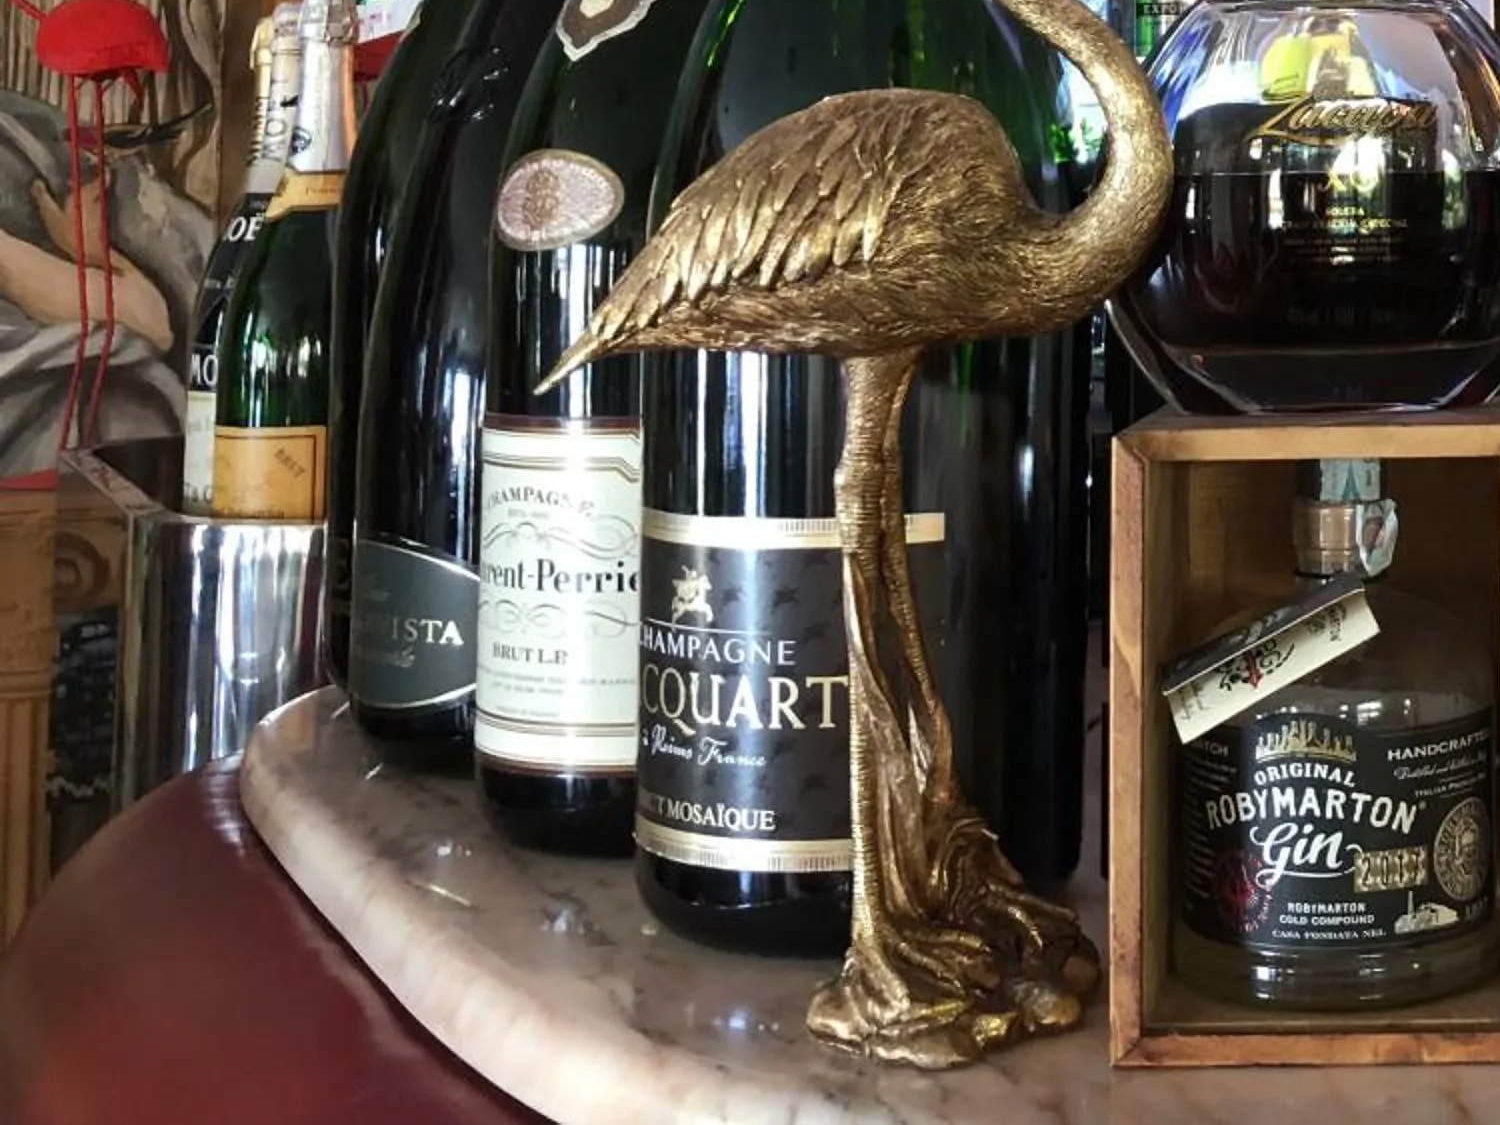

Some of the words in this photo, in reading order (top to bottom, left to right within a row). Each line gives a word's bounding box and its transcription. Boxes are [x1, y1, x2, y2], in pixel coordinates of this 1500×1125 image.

[493, 642, 533, 662] BRUT
[697, 735, 767, 766] France
[1254, 759, 1356, 789] ORIGINAL
[666, 799, 776, 832] MOSAÏQUE
[1205, 785, 1417, 835] ROBYMARTON
[1249, 822, 1367, 891] Gin
[1279, 914, 1308, 925] COLD
[1311, 914, 1375, 926] COMPOUND
[1286, 901, 1367, 913] ROBYMARTON
